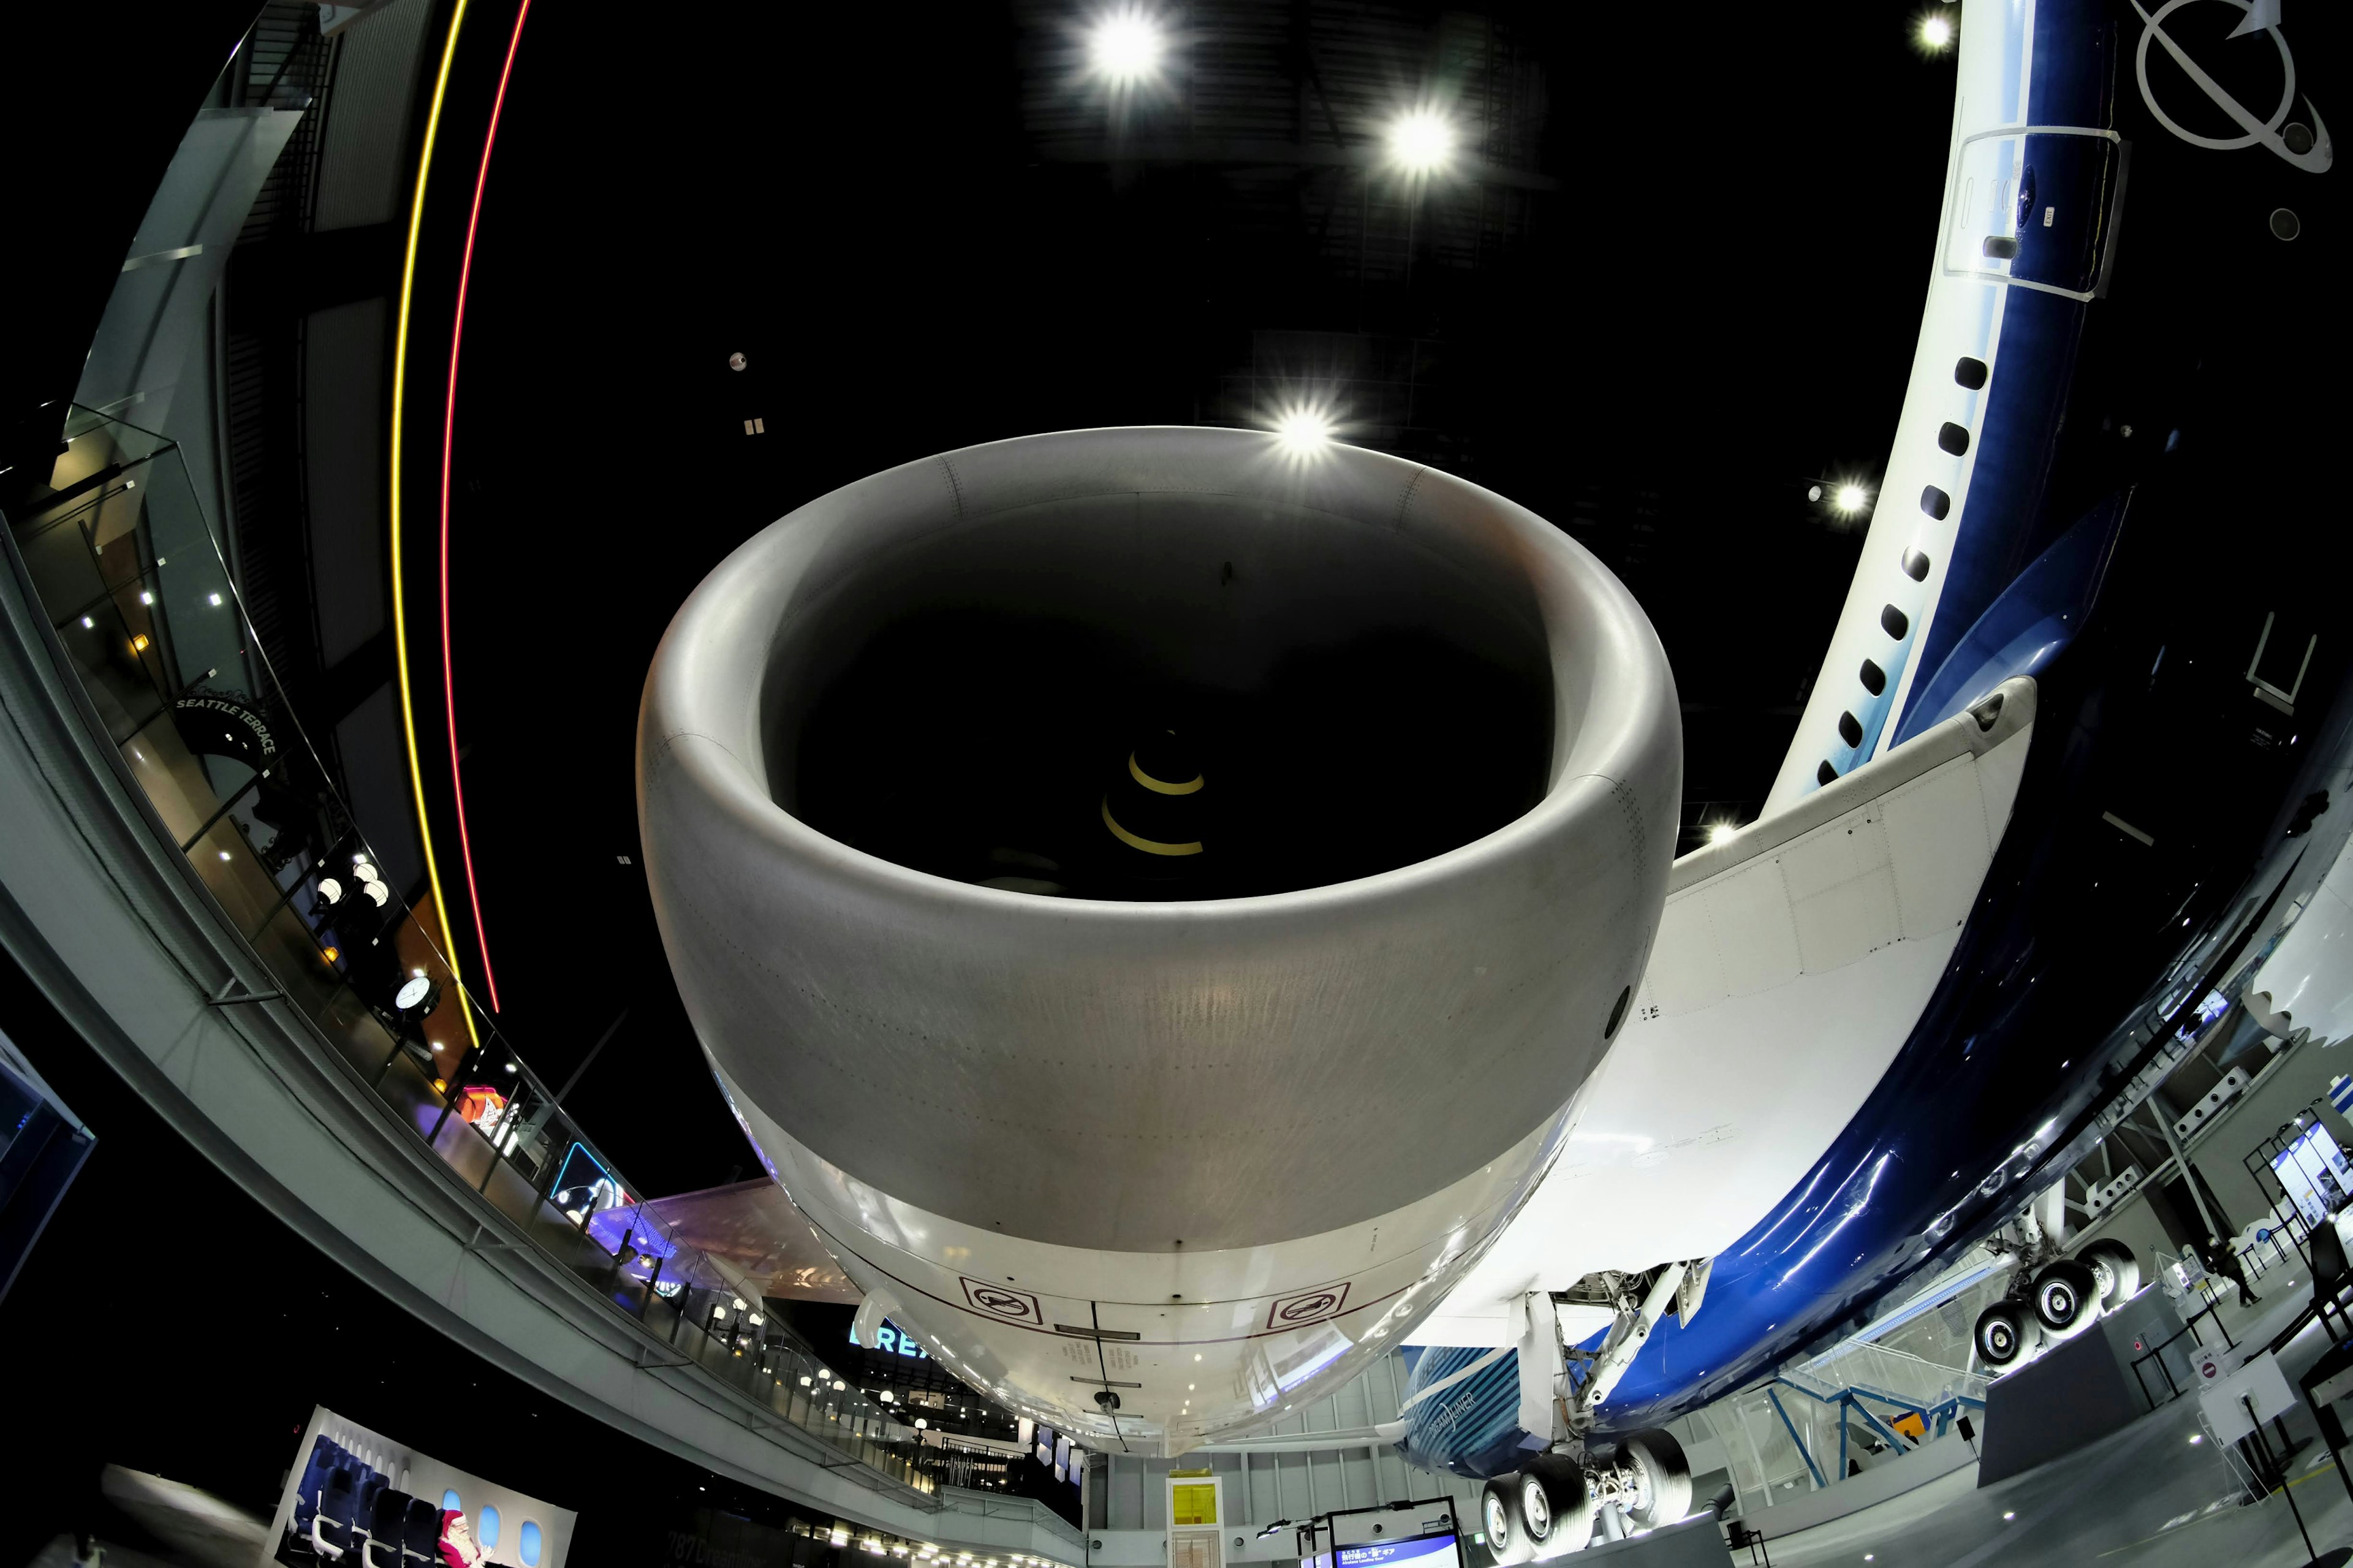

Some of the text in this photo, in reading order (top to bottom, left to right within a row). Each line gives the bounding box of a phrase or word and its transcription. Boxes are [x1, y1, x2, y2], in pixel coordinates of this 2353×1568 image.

[176, 699, 276, 755] SEATTLE TERRACE
[849, 1321, 928, 1359] RE
[1428, 1392, 1476, 1439] DREAMLINER
